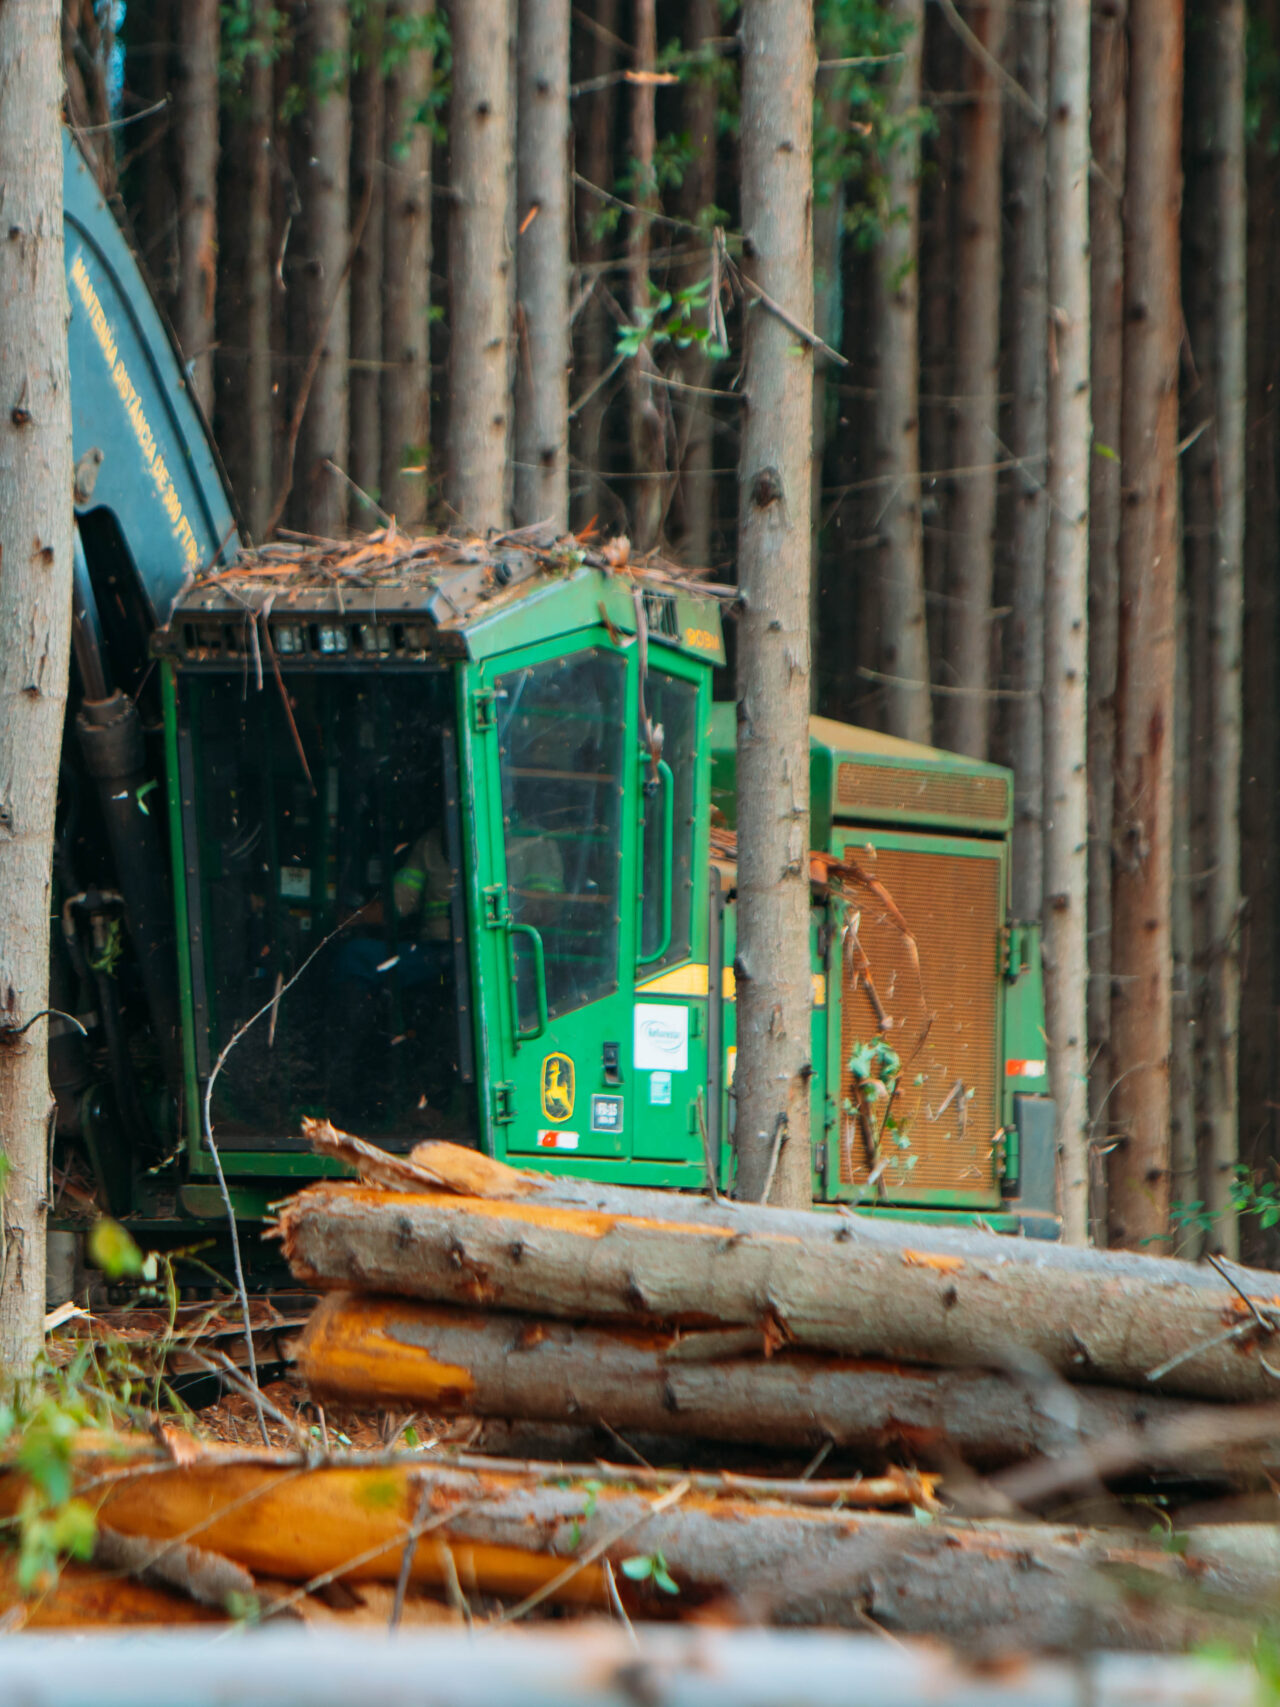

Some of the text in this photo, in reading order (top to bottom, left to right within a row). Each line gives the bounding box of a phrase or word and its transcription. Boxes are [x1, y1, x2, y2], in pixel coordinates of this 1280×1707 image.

[72, 257, 118, 369] MANTENHA
[112, 360, 157, 464] DISTÂNCIA
[151, 455, 169, 491] DE
[163, 483, 182, 523] 300
